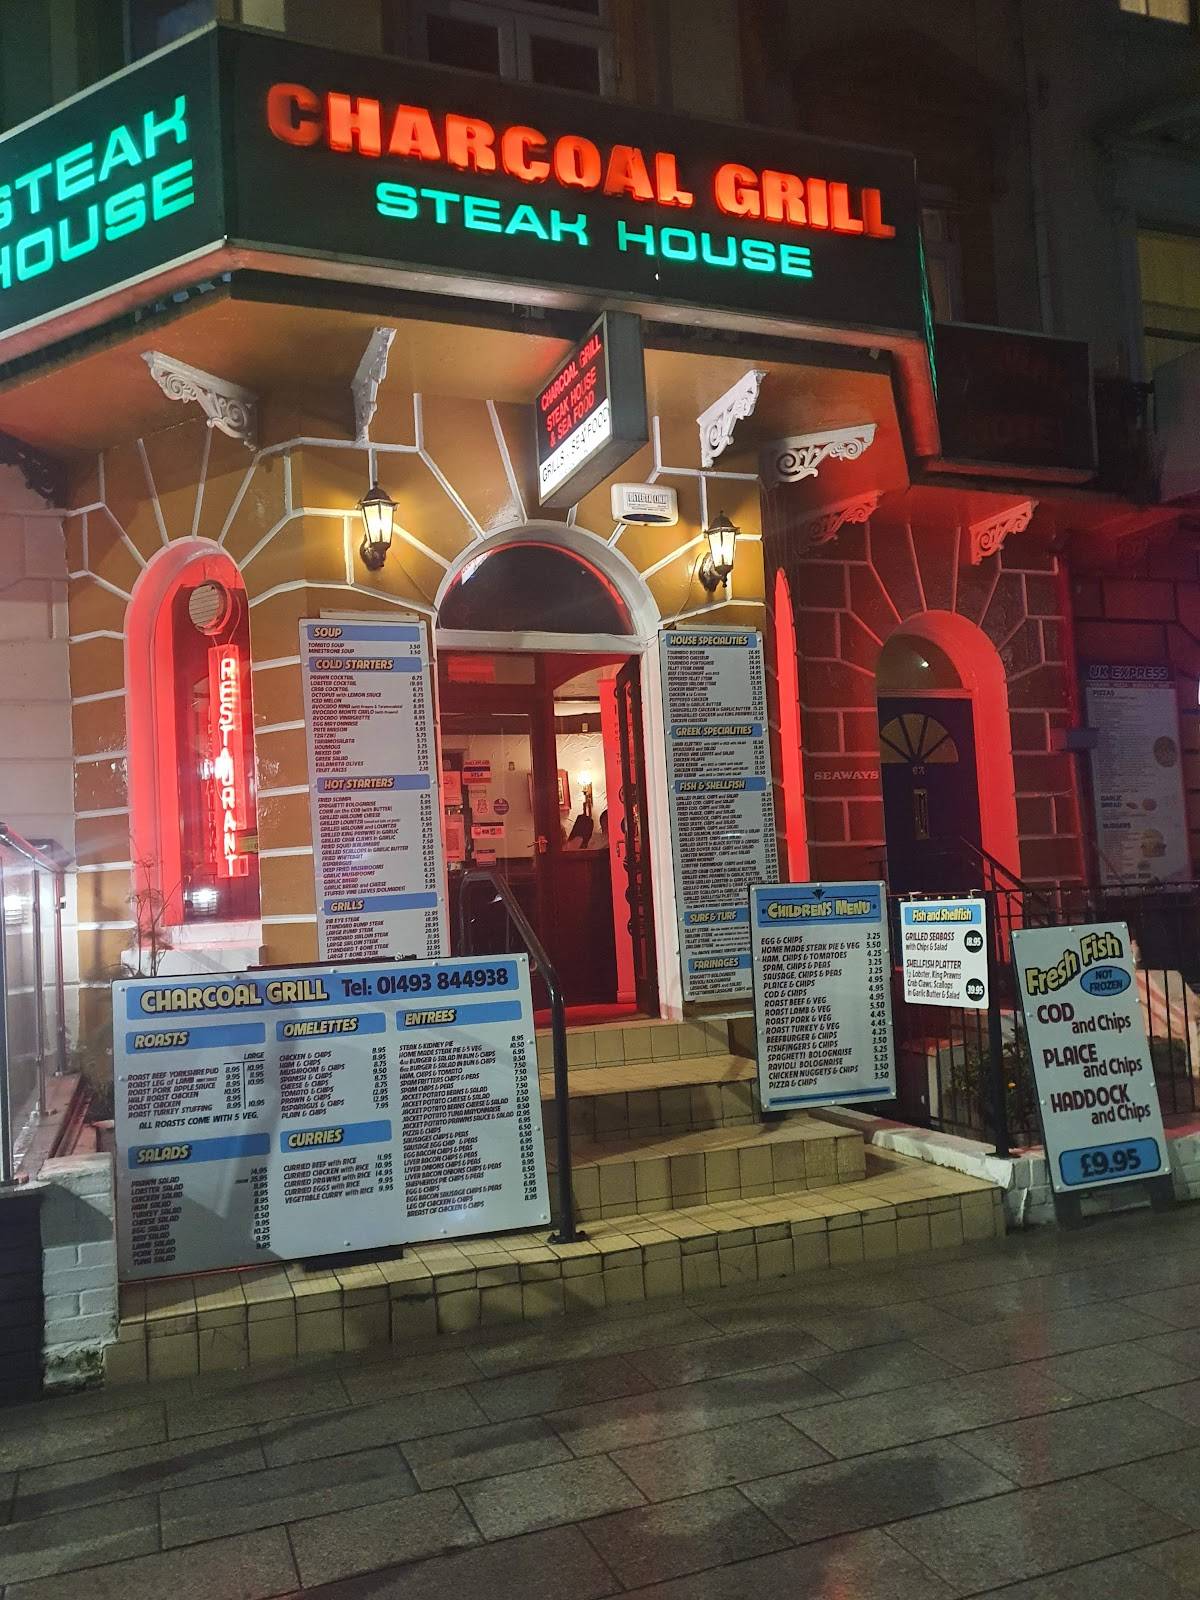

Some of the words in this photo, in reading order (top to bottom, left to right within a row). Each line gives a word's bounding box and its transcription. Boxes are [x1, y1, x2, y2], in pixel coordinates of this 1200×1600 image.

[266, 83, 693, 207] CHARCOAL
[715, 163, 896, 239] GRILL
[376, 182, 589, 245] STEAK
[618, 220, 813, 278] HOUSE
[541, 361, 579, 412] CHARCOAL
[579, 334, 602, 369] GRILL
[547, 397, 570, 432] STEAK
[571, 366, 597, 407] HOUSE
[558, 415, 573, 440] SEA
[573, 391, 595, 424] FOOD
[314, 627, 343, 638] SOUP
[670, 636, 697, 646] HOUSE
[698, 636, 748, 646] SPECIALITIES
[315, 659, 343, 670] COLD
[344, 659, 394, 670] STARTERS
[1111, 665, 1168, 680] EXPRESS
[676, 726, 702, 737] GREEK
[703, 725, 752, 737] SPECIALITIES
[813, 770, 879, 780] SEAWAYS
[324, 780, 346, 791] HOT
[346, 778, 394, 790] STARTERS
[680, 782, 697, 792] FISH
[706, 780, 745, 790] SHELLFISH
[330, 900, 364, 912] GRILLS
[835, 898, 871, 916] MENU
[690, 913, 709, 923] SURF
[717, 911, 737, 921] TURF
[912, 909, 926, 921] Fish
[926, 909, 940, 921] and
[940, 907, 972, 921] Shellfish
[760, 936, 774, 944] EGG
[776, 936, 781, 944] &
[782, 935, 802, 943] CHIPS
[905, 932, 928, 940] GRILLED
[929, 932, 954, 940] SEABASS
[966, 937, 981, 946] 18.95
[761, 945, 782, 953] HOME
[783, 944, 804, 953] MADE
[805, 943, 827, 952] STEAK
[828, 942, 838, 951] PIE
[839, 942, 845, 950] &
[846, 942, 860, 950] VEG
[916, 942, 928, 951] Chips
[929, 942, 932, 950] &
[934, 942, 947, 950] Salad
[761, 954, 780, 962] HAM,
[782, 953, 801, 961] CHIPS
[809, 951, 847, 960] TOMATOES
[693, 958, 739, 969] FARINAGES
[762, 963, 784, 971] SPAM,
[786, 962, 805, 970] CHIPS
[807, 961, 812, 969] &
[813, 960, 830, 969] PEAS
[906, 959, 934, 968] SHELLFISH
[935, 959, 961, 969] PLATTER
[1025, 949, 1081, 997] Fresh
[1080, 931, 1124, 967] Fish
[762, 971, 795, 980] SAUSAGE,
[798, 970, 817, 978] CHIPS
[818, 969, 823, 977] &
[824, 969, 842, 977] PEAS
[931, 971, 942, 980] King
[1096, 970, 1113, 980] NOT
[763, 980, 787, 989] PLAICE
[789, 980, 794, 988] &
[795, 979, 815, 988] CHIPS
[907, 979, 917, 987] Crab
[933, 980, 952, 990] Scallops
[1090, 980, 1123, 993] FROZEN
[140, 982, 261, 1015] CHARCOAL
[265, 977, 329, 1005] GRILL
[341, 977, 372, 998] Tel:
[376, 973, 432, 995] 01493
[436, 967, 508, 990] 844938
[764, 990, 779, 998] COD
[781, 989, 785, 997] &
[786, 988, 806, 997] CHIPS
[926, 989, 941, 998] Butter
[942, 990, 945, 998] &
[946, 991, 959, 999] Salad
[764, 998, 788, 1007] ROAST
[789, 997, 805, 1006] BEEF
[806, 997, 811, 1005] &
[812, 996, 826, 1004] VEG
[404, 1008, 456, 1026] ENTREES
[1037, 1002, 1075, 1025] COD
[283, 1016, 358, 1037] OMELETTES
[765, 1025, 789, 1034] ROAST
[791, 1023, 817, 1032] TURKEY
[819, 1023, 824, 1031] &
[826, 1022, 839, 1030] VEG
[1072, 1016, 1096, 1034] and
[1098, 1013, 1132, 1034] Chips
[133, 1030, 189, 1050] ROASTS
[766, 1033, 809, 1043] BEEFBURGER
[811, 1032, 816, 1040] &
[817, 1031, 837, 1040] CHIPS
[243, 1051, 264, 1060] LARGE
[1042, 1043, 1098, 1069] PLAICE
[768, 1069, 798, 1079] CHICKEN
[799, 1067, 831, 1077] NUGGETS
[832, 1066, 837, 1075] &
[838, 1065, 858, 1074] CHIPS
[1083, 1060, 1108, 1078] and
[1109, 1057, 1143, 1079] Chips
[1050, 1083, 1131, 1113] HADDOCK
[1092, 1107, 1116, 1125] and
[1117, 1102, 1151, 1125] Chips
[138, 1121, 152, 1130] ALL
[154, 1118, 185, 1129] ROASTS
[187, 1115, 210, 1125] COME
[213, 1113, 232, 1123] WITH
[234, 1112, 239, 1121] 5
[242, 1111, 258, 1120] VEG.
[287, 1127, 343, 1148] CURRIES
[136, 1143, 191, 1165] SALADS
[1080, 1148, 1142, 1178] £9.95
[283, 1170, 310, 1179] CURRIED
[354, 1163, 369, 1171] RICE
